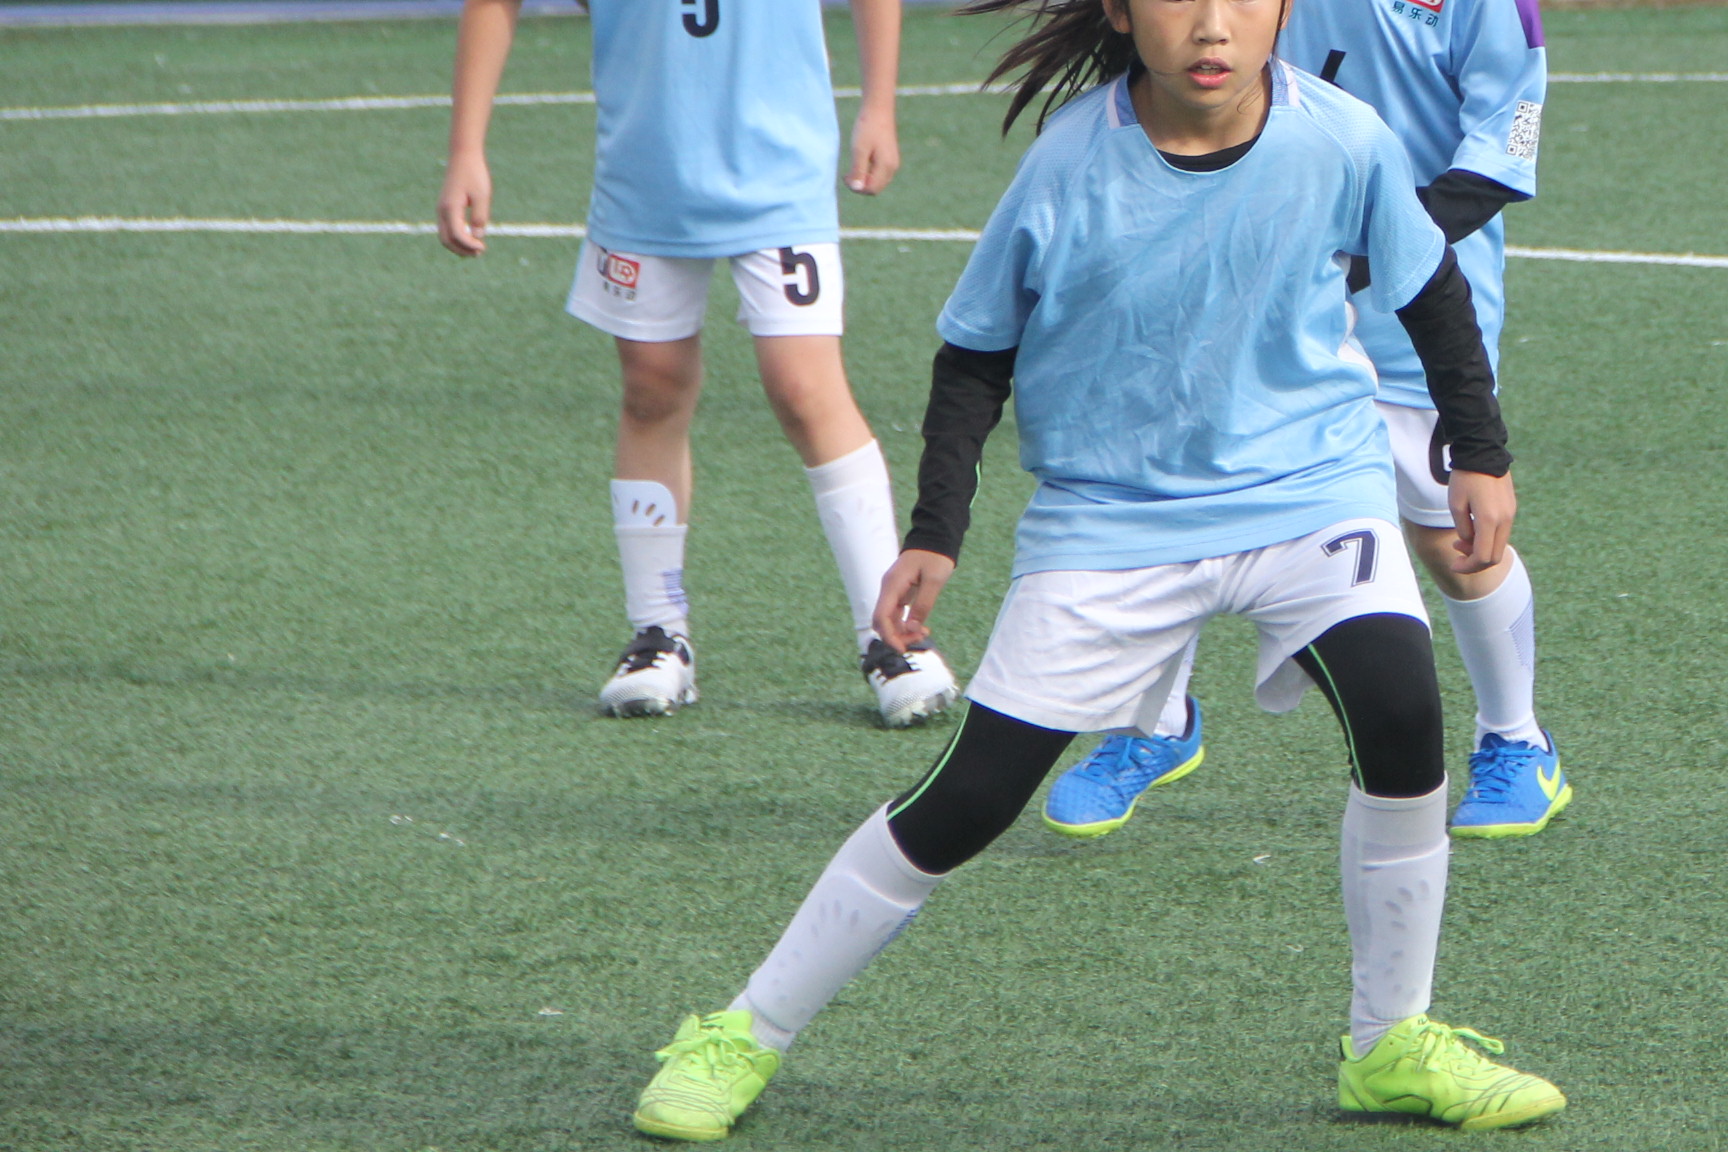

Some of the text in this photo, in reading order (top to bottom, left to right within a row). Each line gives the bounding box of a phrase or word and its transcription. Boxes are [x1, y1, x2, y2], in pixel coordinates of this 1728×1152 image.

[1391, 0, 1439, 28] 易乐动
[778, 246, 820, 306] 5
[1320, 528, 1380, 587] 7
